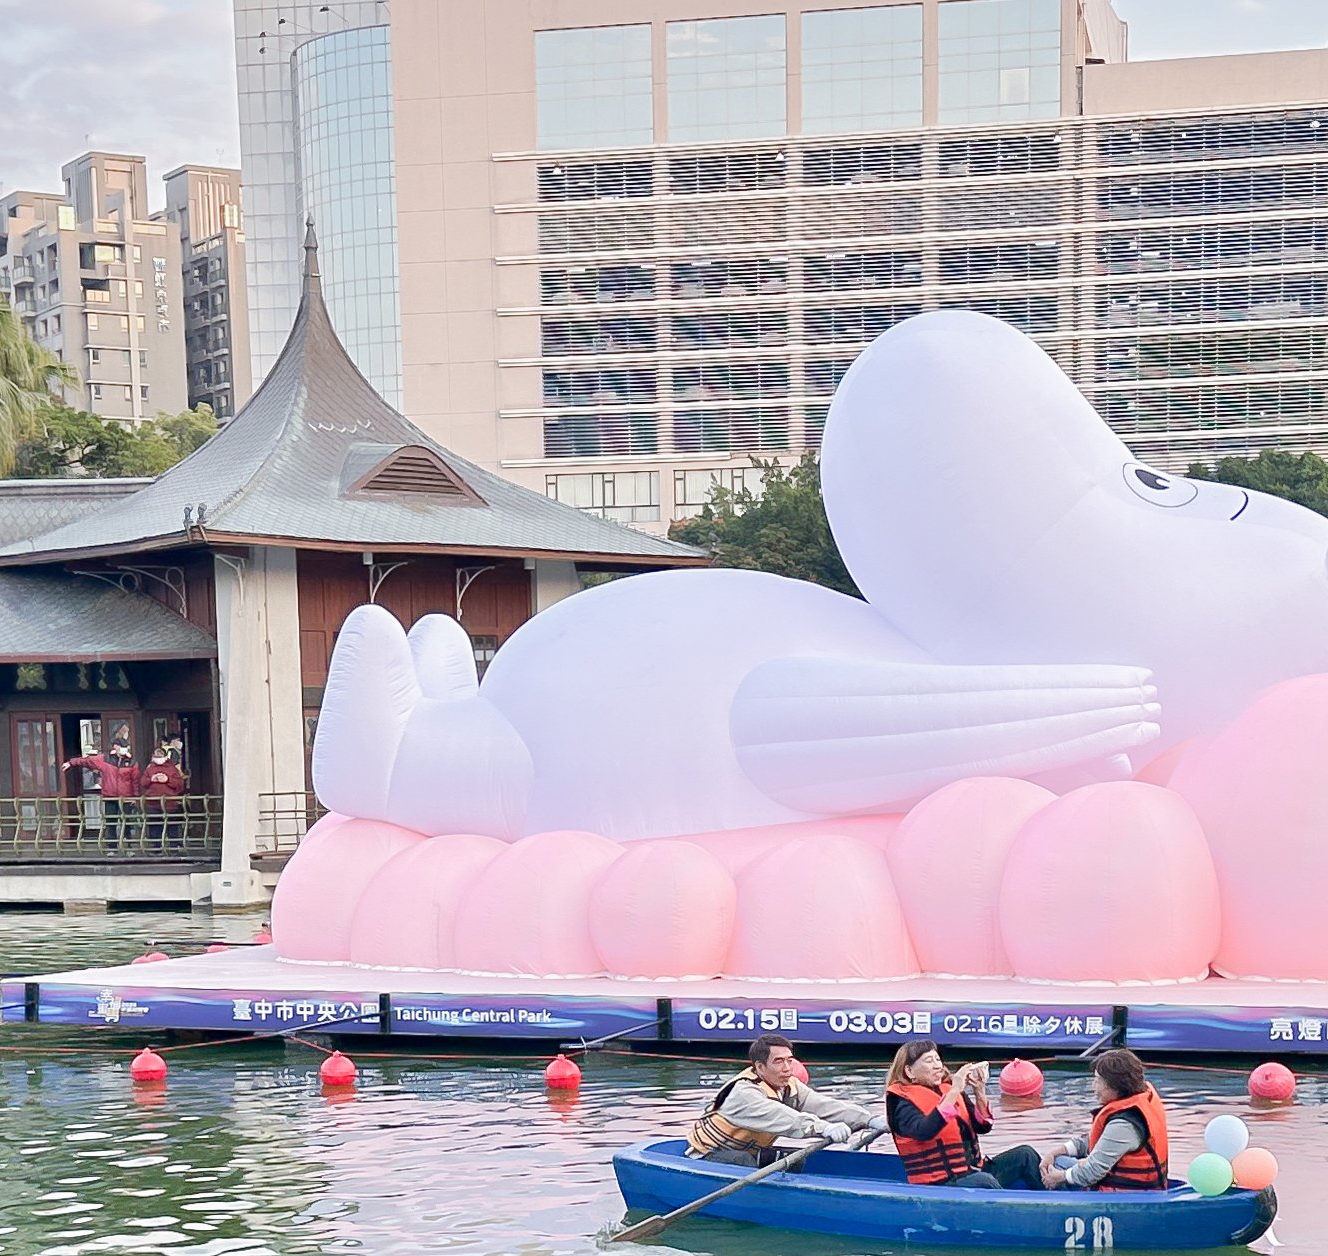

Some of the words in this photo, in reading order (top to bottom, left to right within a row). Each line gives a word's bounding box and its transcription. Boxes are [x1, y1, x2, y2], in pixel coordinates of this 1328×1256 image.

[232, 998, 380, 1024] 臺中市中央公園
[394, 1006, 459, 1024] Taichung
[461, 1007, 515, 1023] Central
[518, 1009, 552, 1023] Park
[1064, 1216, 1114, 1248] 28
